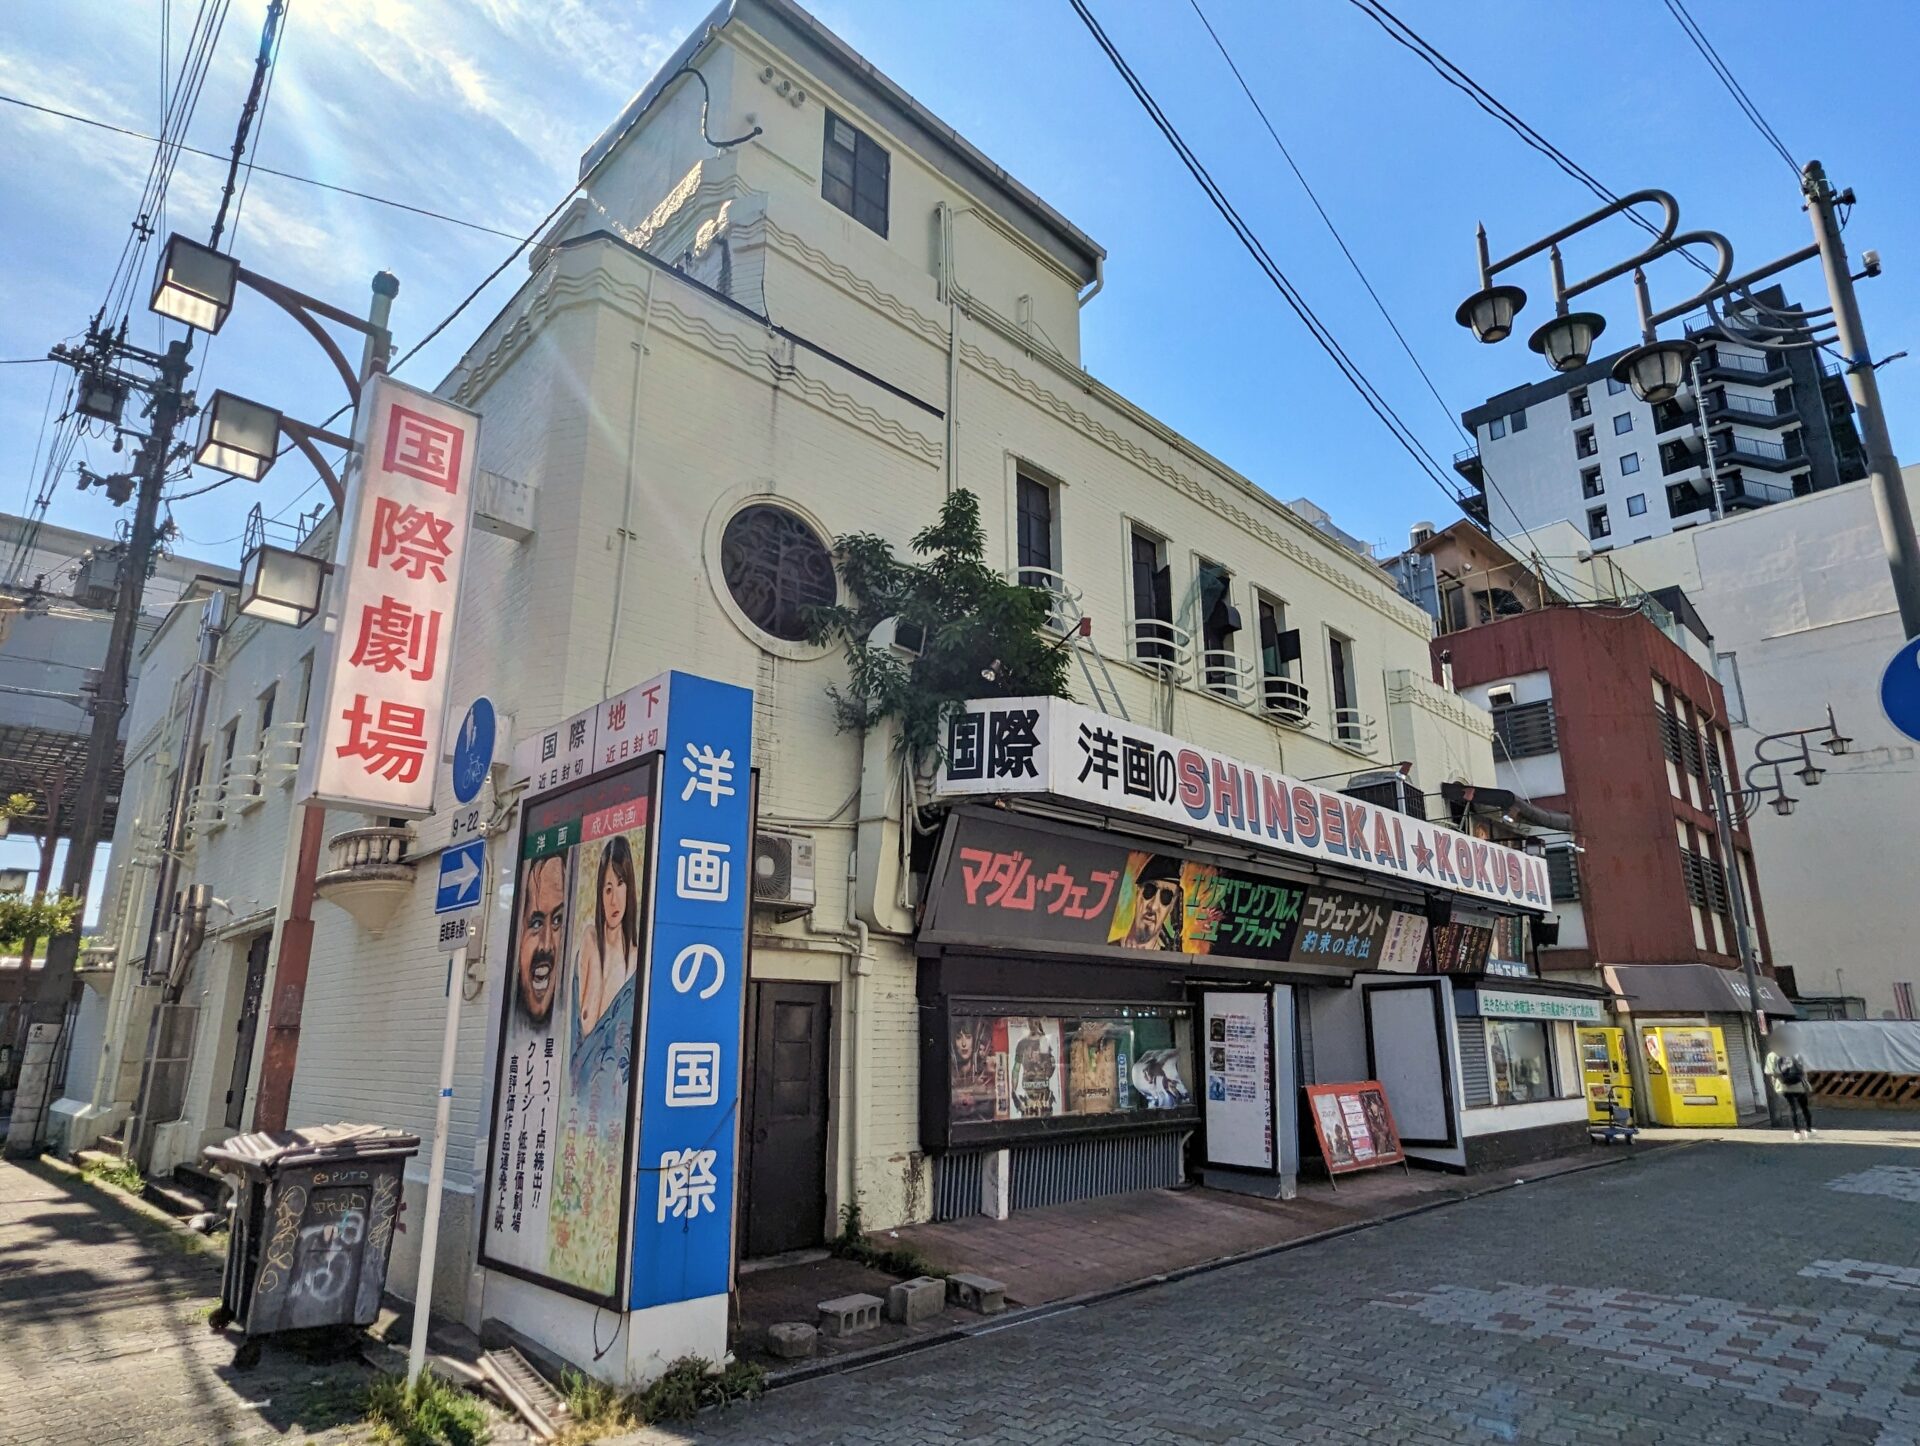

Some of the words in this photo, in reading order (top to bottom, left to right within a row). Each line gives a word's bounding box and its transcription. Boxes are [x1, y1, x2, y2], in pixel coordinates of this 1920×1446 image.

[335, 403, 465, 784] 国際劇場
[607, 684, 662, 732] 地下
[541, 719, 587, 764] 国際
[605, 728, 659, 765] 近日封切
[946, 709, 1041, 781] 国際
[538, 758, 584, 790] 近日封切
[452, 810, 479, 838] 9-22
[591, 806, 636, 835] 成人映画
[1303, 894, 1385, 936] コヴェナント
[1300, 930, 1372, 959] 約束の救出
[657, 741, 736, 1224] 洋画の国際
